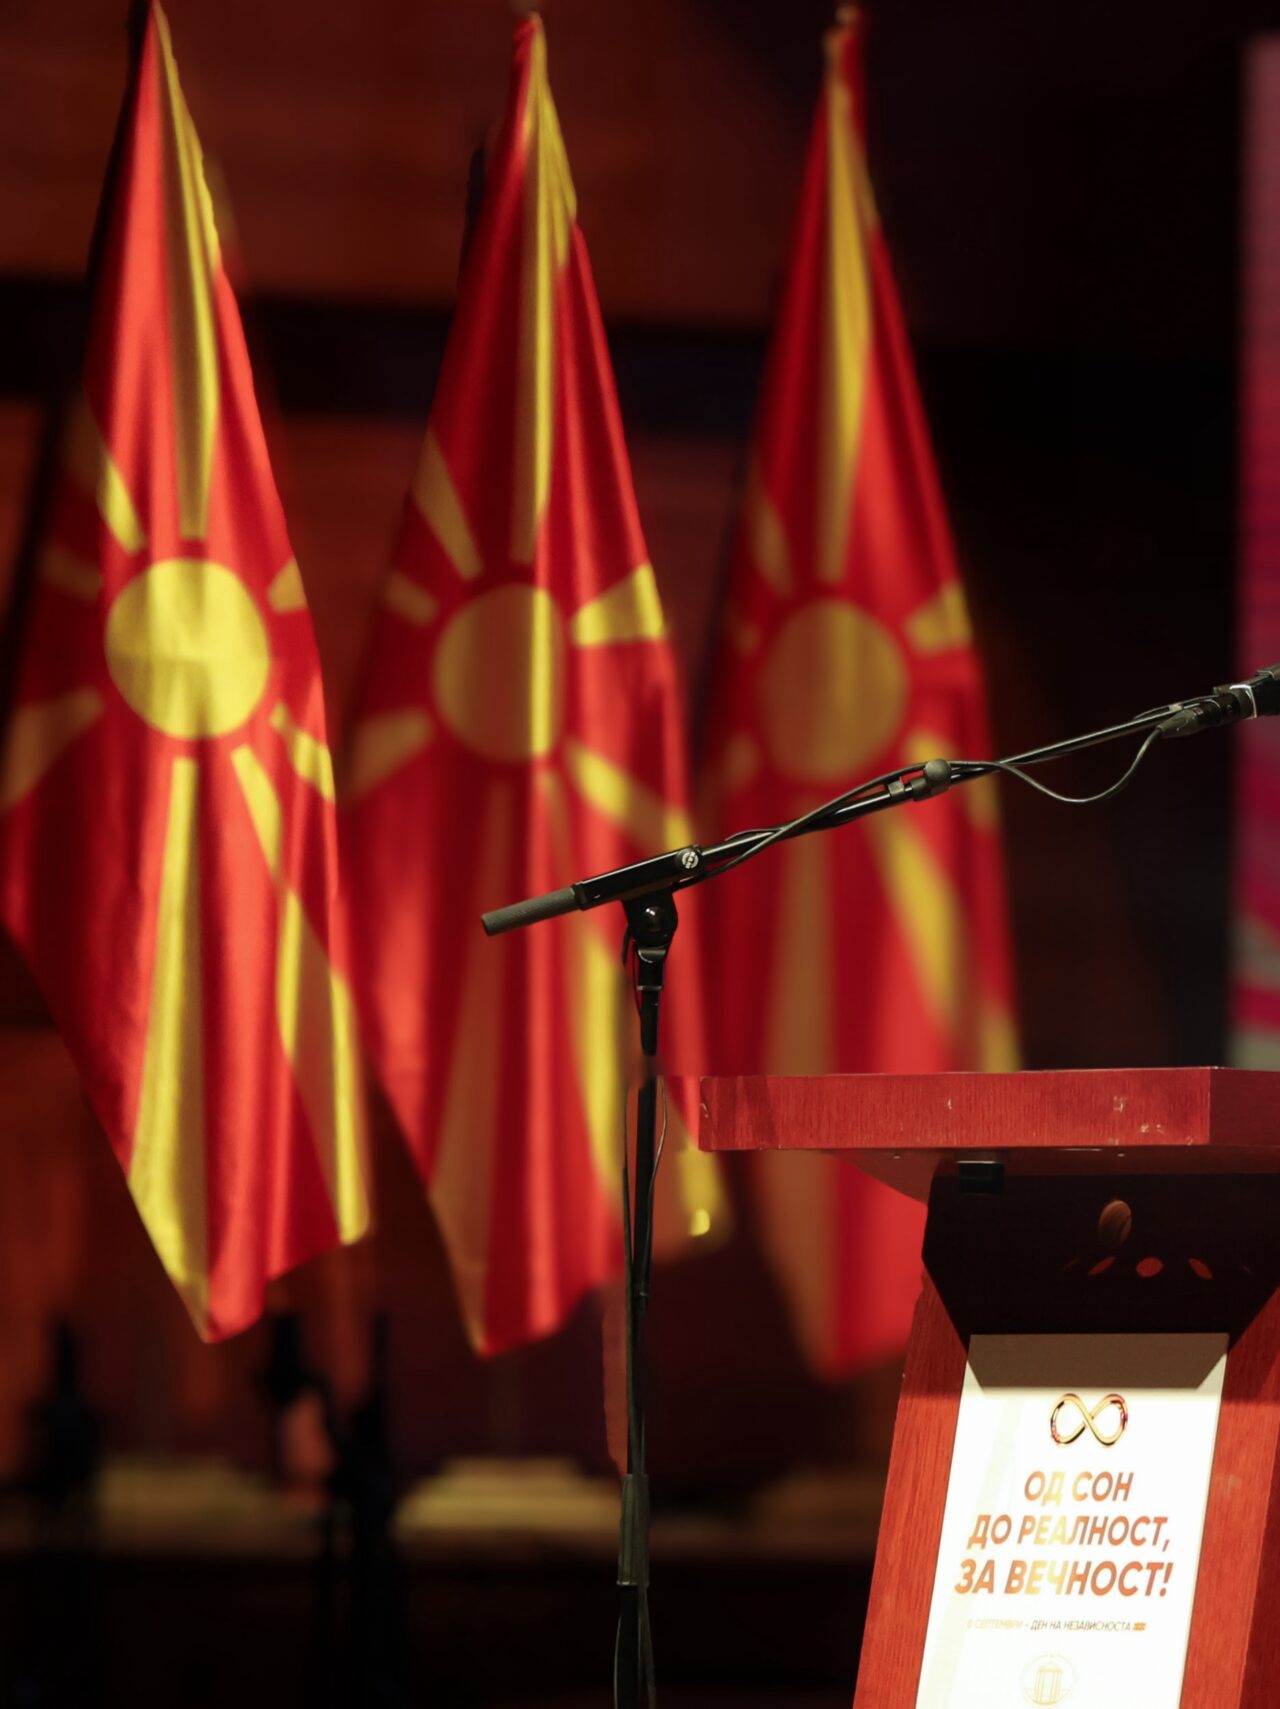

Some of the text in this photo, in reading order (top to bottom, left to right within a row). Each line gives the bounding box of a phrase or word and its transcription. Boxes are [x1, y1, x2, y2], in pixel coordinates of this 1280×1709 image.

[1023, 1470, 1135, 1507] ОД СОН
[965, 1513, 1172, 1553] ДО РЕАЛНОСТ,
[953, 1557, 1175, 1599] ЗА ВЕЧНОСТ!
[1030, 1619, 1049, 1631] ДЕН
[1049, 1620, 1062, 1630] НА
[1063, 1620, 1132, 1632] НЕЗАВИСНОСТА
